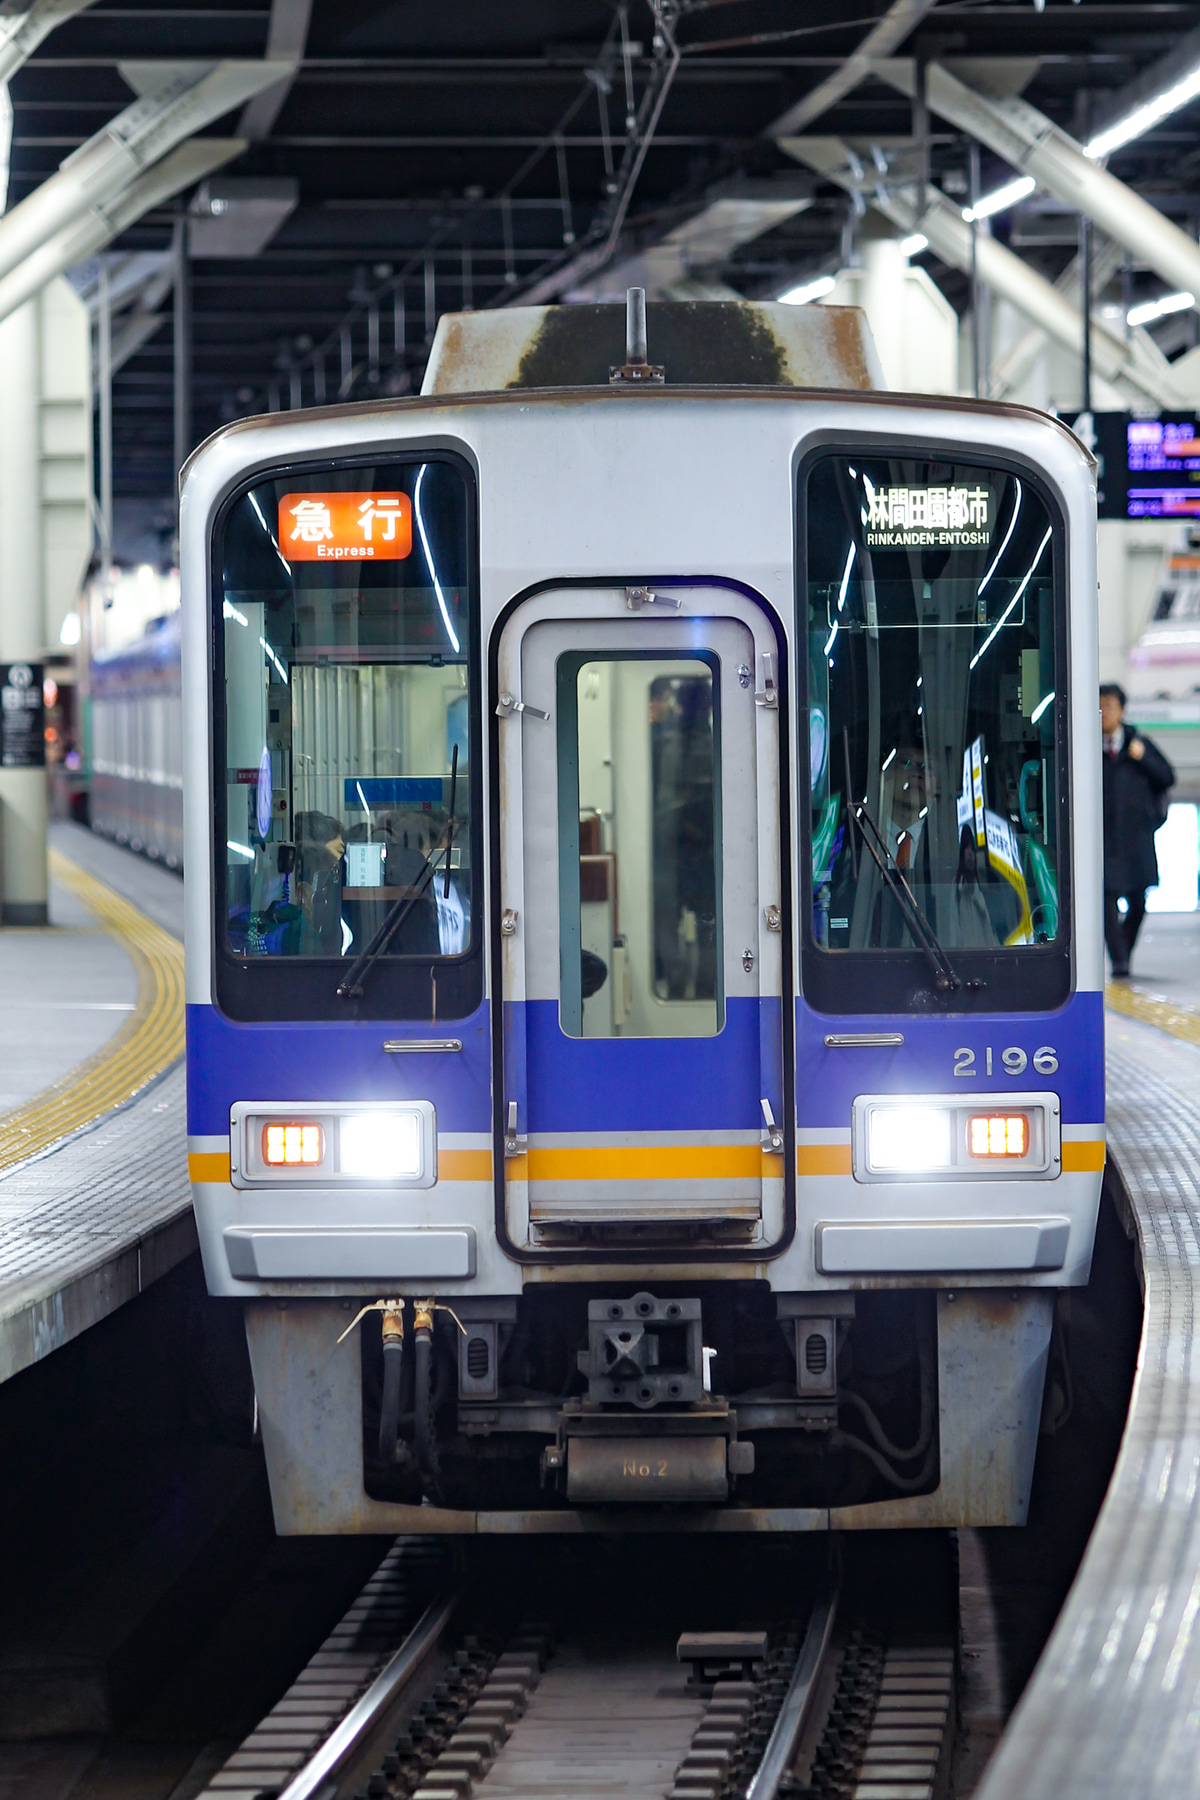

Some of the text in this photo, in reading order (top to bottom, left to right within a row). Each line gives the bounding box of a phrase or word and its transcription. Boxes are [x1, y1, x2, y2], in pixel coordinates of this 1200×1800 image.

[867, 486, 989, 530] 林間田園都市
[289, 499, 402, 542] 急行
[867, 532, 990, 545] RINKANDEN-ENTOSHI
[317, 544, 375, 559] Express
[953, 1046, 1059, 1077] 2196
[622, 1459, 668, 1477] No.2
